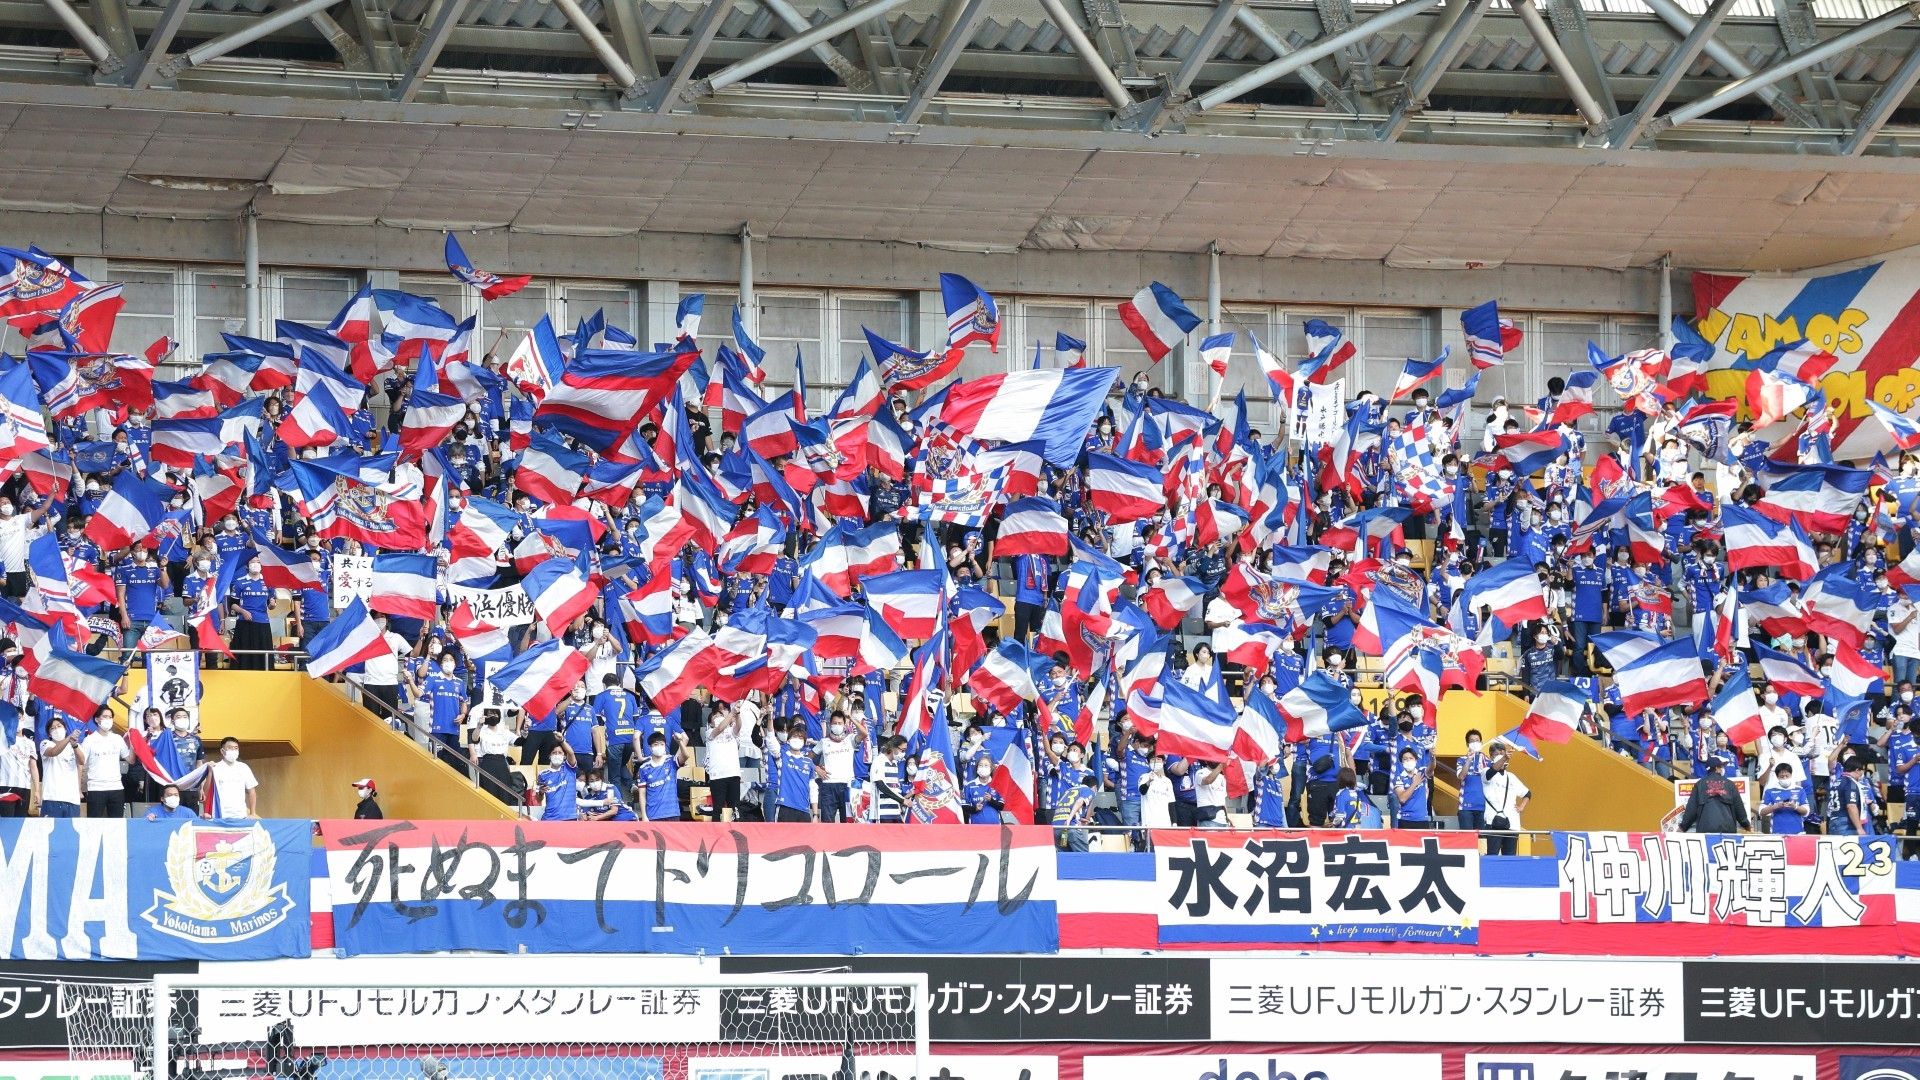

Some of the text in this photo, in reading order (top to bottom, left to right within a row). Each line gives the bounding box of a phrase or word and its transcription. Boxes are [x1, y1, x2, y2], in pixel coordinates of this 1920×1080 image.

[1698, 307, 1869, 360] VAMOS
[338, 571, 373, 589] 愛する
[340, 558, 368, 569] 共に
[615, 698, 626, 719] 7
[337, 821, 1040, 933] 死ぬまでトリコロール
[1168, 835, 1467, 917] 水沼宏太
[1563, 835, 1894, 924] 仲川輝人 23
[163, 908, 278, 937] Yokohama Marinos
[1337, 925, 1358, 937] keep
[1401, 924, 1444, 939] forward
[1228, 984, 1666, 1017] 三菱UFJモルガン・スタンレー証券
[1699, 986, 1920, 1019] 三菱UFJモルガ
